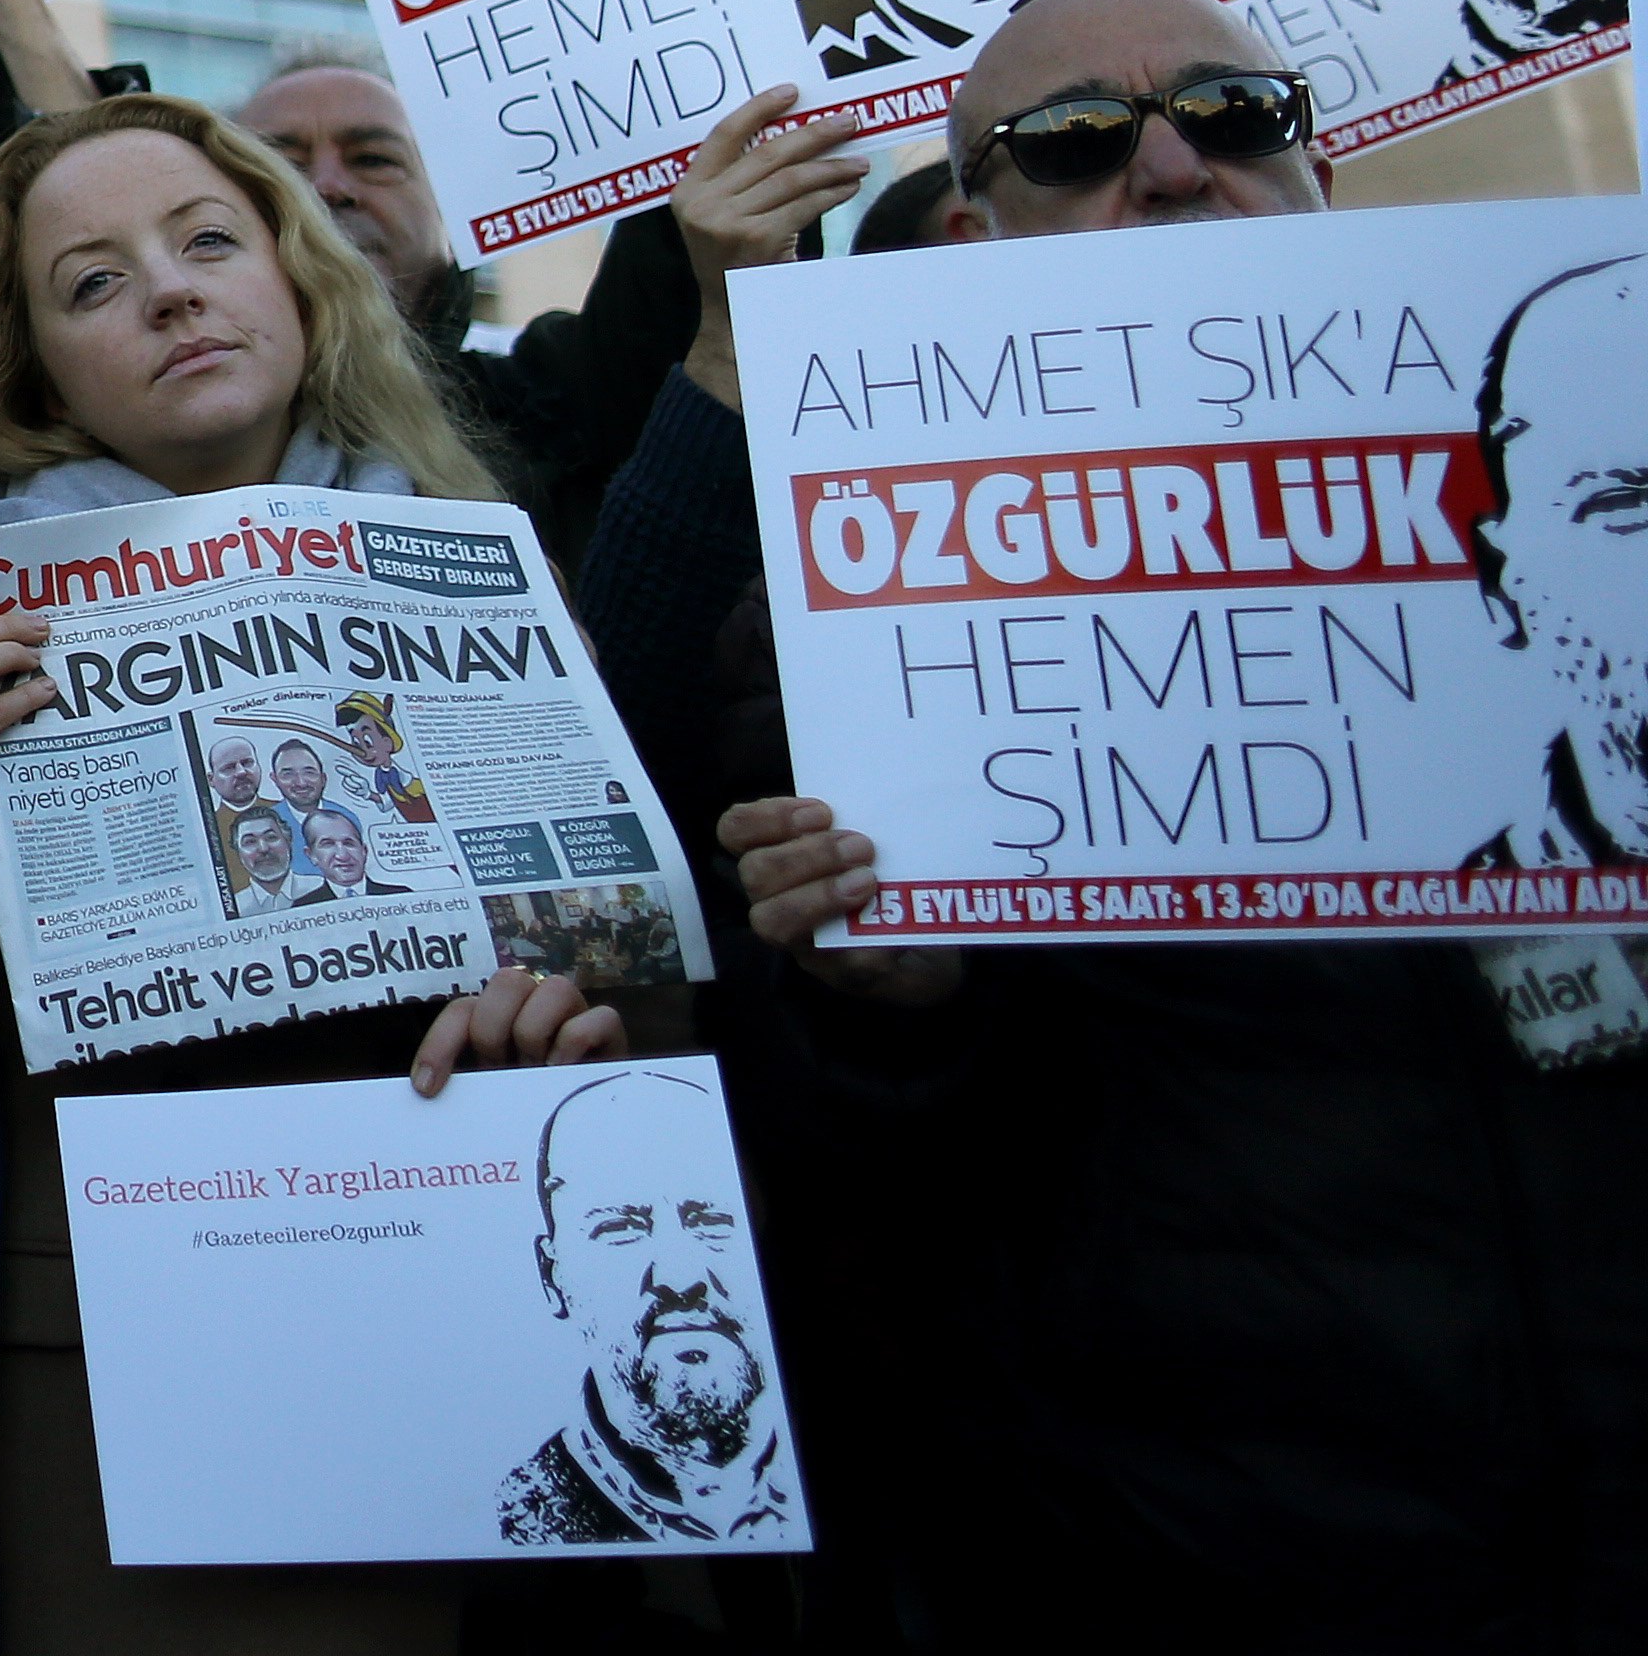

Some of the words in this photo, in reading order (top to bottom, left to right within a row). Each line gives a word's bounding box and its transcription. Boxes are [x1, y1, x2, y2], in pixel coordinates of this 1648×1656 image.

[498, 10, 755, 192] ŞİMDİ
[479, 217, 514, 247] 25
[516, 180, 618, 234] EYLÜL'DE
[616, 158, 686, 204] SAAT:
[791, 323, 1153, 437] AHMET
[1187, 305, 1457, 427] ŞIK'A
[808, 450, 1468, 596] ÖZGÜRLÜK
[367, 530, 510, 565] GAZETECİLERİ
[373, 558, 440, 583] SERBEST
[446, 566, 517, 589] BIRAKIN
[54, 626, 115, 646] susturma
[119, 604, 227, 638] operasyonunun
[228, 594, 268, 613] birinci
[339, 614, 568, 684] SINAVI
[894, 601, 1417, 720] HEMEN
[1, 757, 80, 785] Yandaş
[83, 748, 139, 774] basın
[8, 785, 65, 816] niyeti
[70, 765, 179, 811] gösteriyor
[982, 718, 1368, 877] ŞİMDİ
[470, 827, 532, 843] KABOĞLU:
[564, 833, 615, 846] GÜNDEM
[569, 819, 610, 833] ÖZGÜR
[466, 843, 507, 856] HUKUK
[470, 854, 516, 868] UMUDU
[517, 851, 534, 864] VE
[569, 845, 613, 859] DAVASI
[615, 843, 632, 856] DA
[574, 857, 616, 872] BUGÜN
[170, 885, 185, 898] DE
[476, 866, 517, 880] İNANCI
[166, 898, 199, 915] OLDU
[859, 891, 904, 926] 25
[911, 885, 1076, 925] EYLÜL'DE
[1081, 884, 1184, 922] SAAT:
[1194, 877, 1364, 921] 13.30'DA
[1371, 875, 1568, 920] ÇAĞLAYAN
[86, 953, 144, 975] Belediye
[145, 940, 195, 961] Başkanı
[198, 932, 227, 951] Edip
[230, 924, 269, 945] Uğur,
[269, 911, 336, 937] hükümeti
[338, 901, 409, 924] suçlayarak
[410, 899, 442, 917] istifa
[444, 897, 471, 912] etti
[210, 961, 274, 1002] ve
[281, 925, 468, 990] baskılar
[83, 1167, 269, 1206] Gazetecilik
[275, 1156, 521, 1200] Yargılanamaz
[192, 1219, 424, 1250] #GazetecilereOzgurluk
